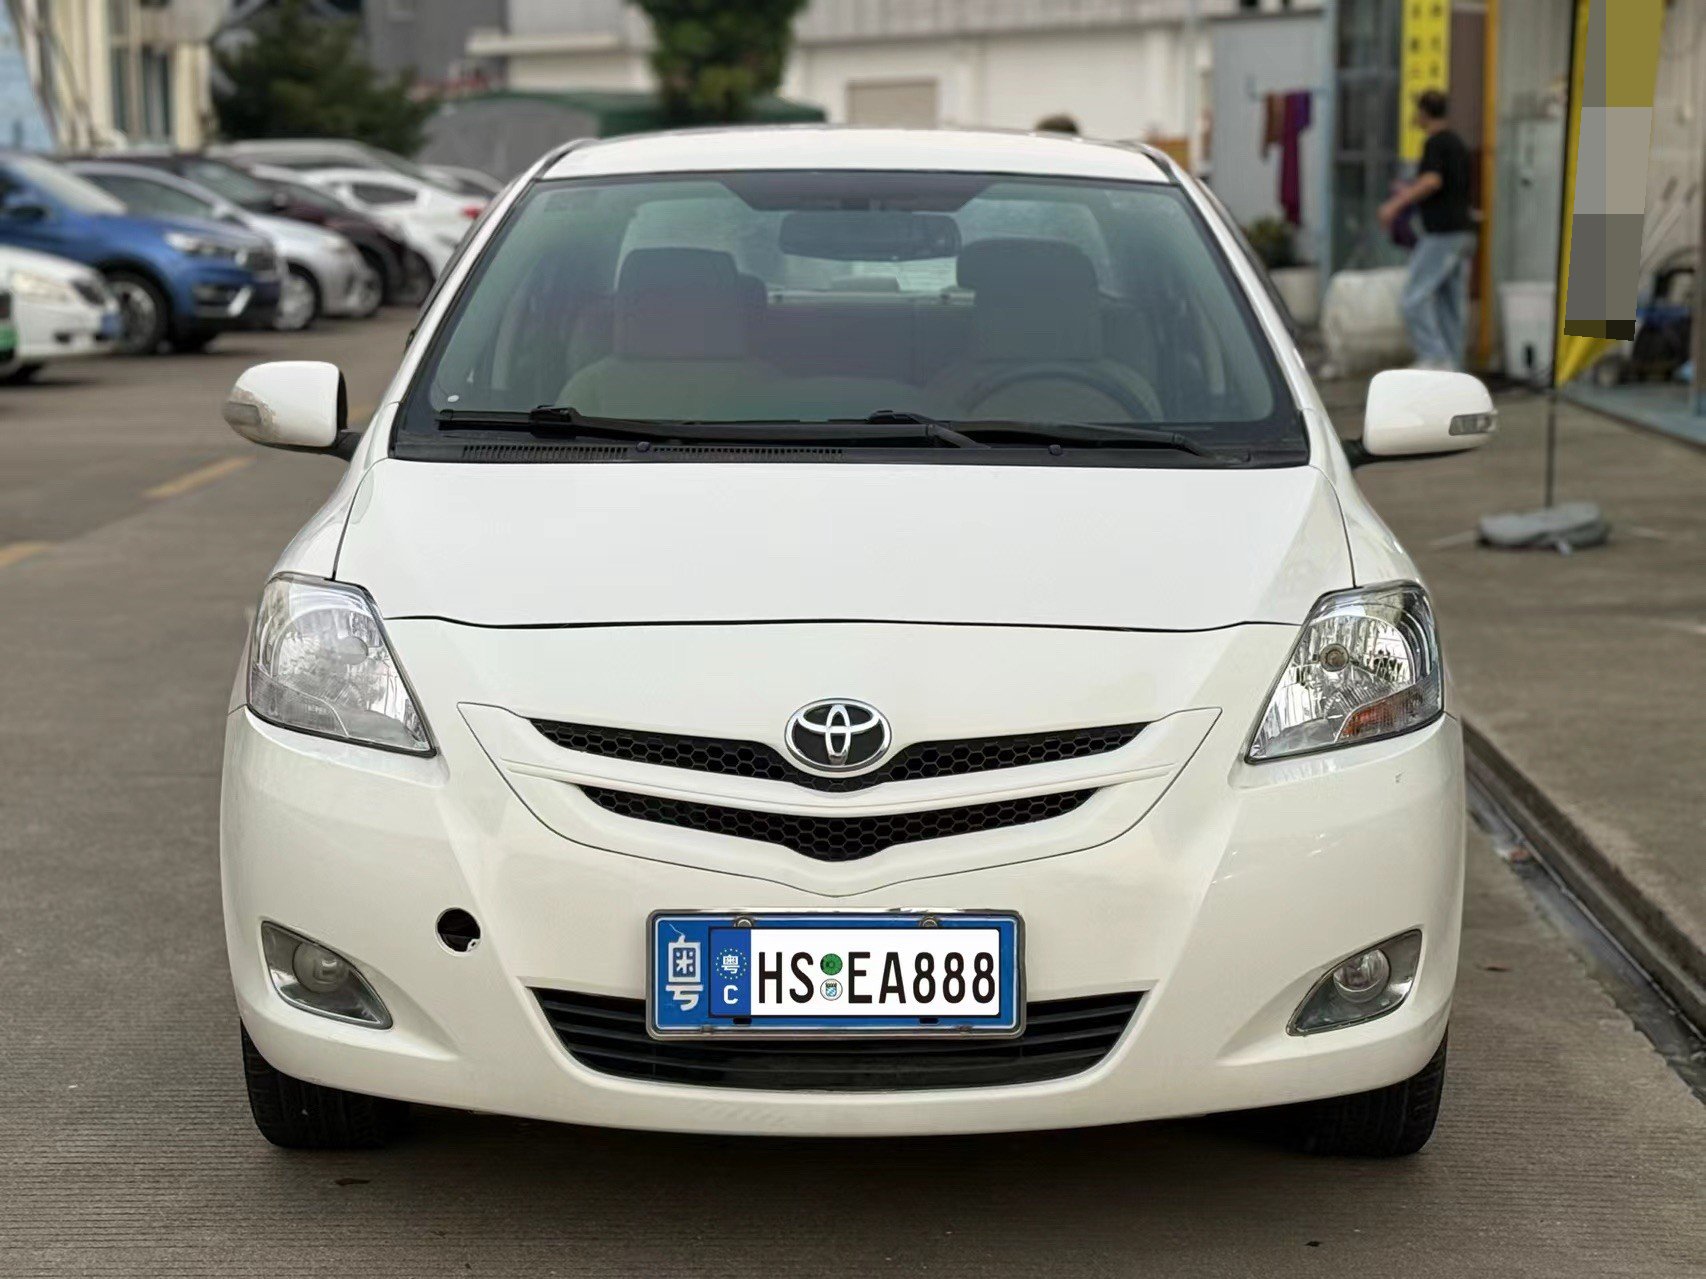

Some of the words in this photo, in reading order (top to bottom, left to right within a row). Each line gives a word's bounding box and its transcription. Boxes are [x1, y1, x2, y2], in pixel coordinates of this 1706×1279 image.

[666, 933, 704, 1011] 粤
[723, 984, 739, 1005] C
[758, 951, 815, 1004] HS
[848, 951, 996, 1004] EA888
